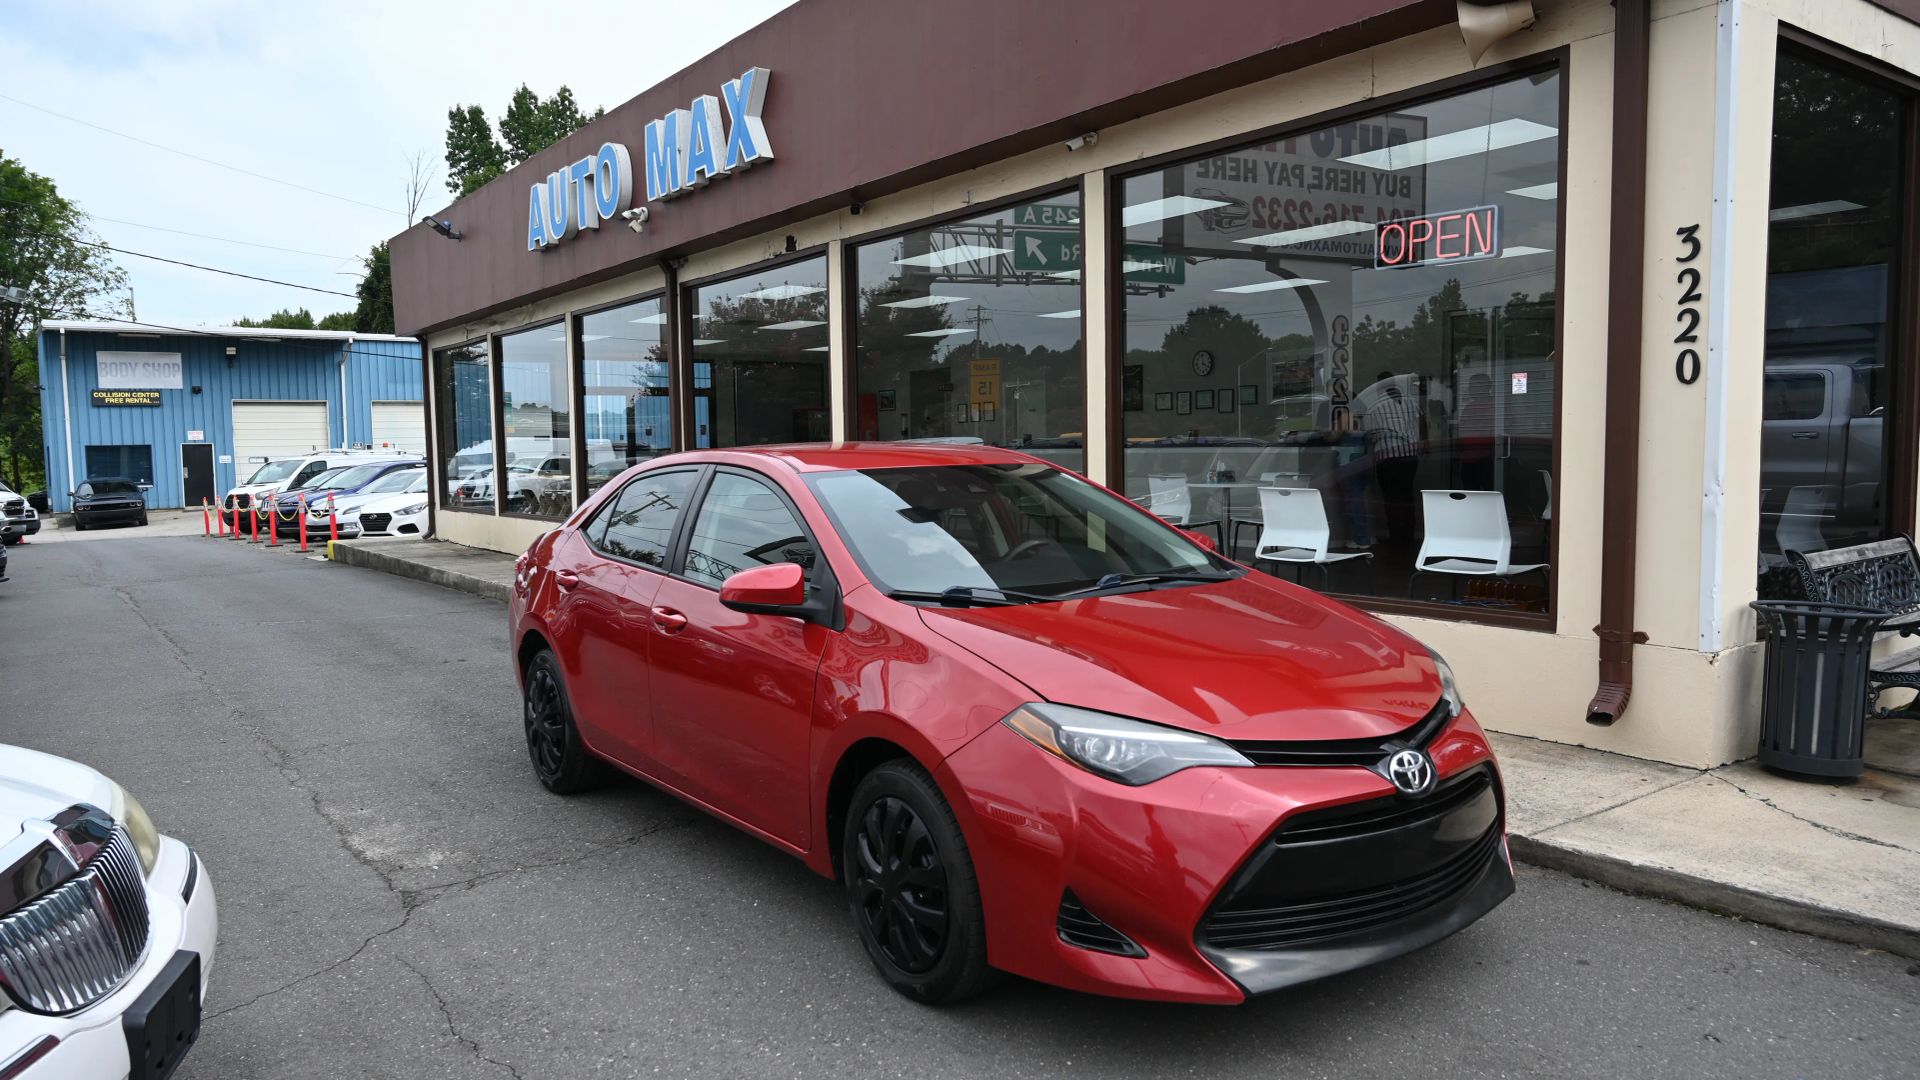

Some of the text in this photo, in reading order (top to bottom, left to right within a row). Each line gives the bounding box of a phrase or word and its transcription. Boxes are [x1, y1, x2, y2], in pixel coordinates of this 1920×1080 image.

[528, 66, 774, 251] AUTO MAX
[1380, 209, 1493, 265] OPEN
[1674, 223, 1702, 385] 3220
[99, 361, 181, 378] BODY SHOP
